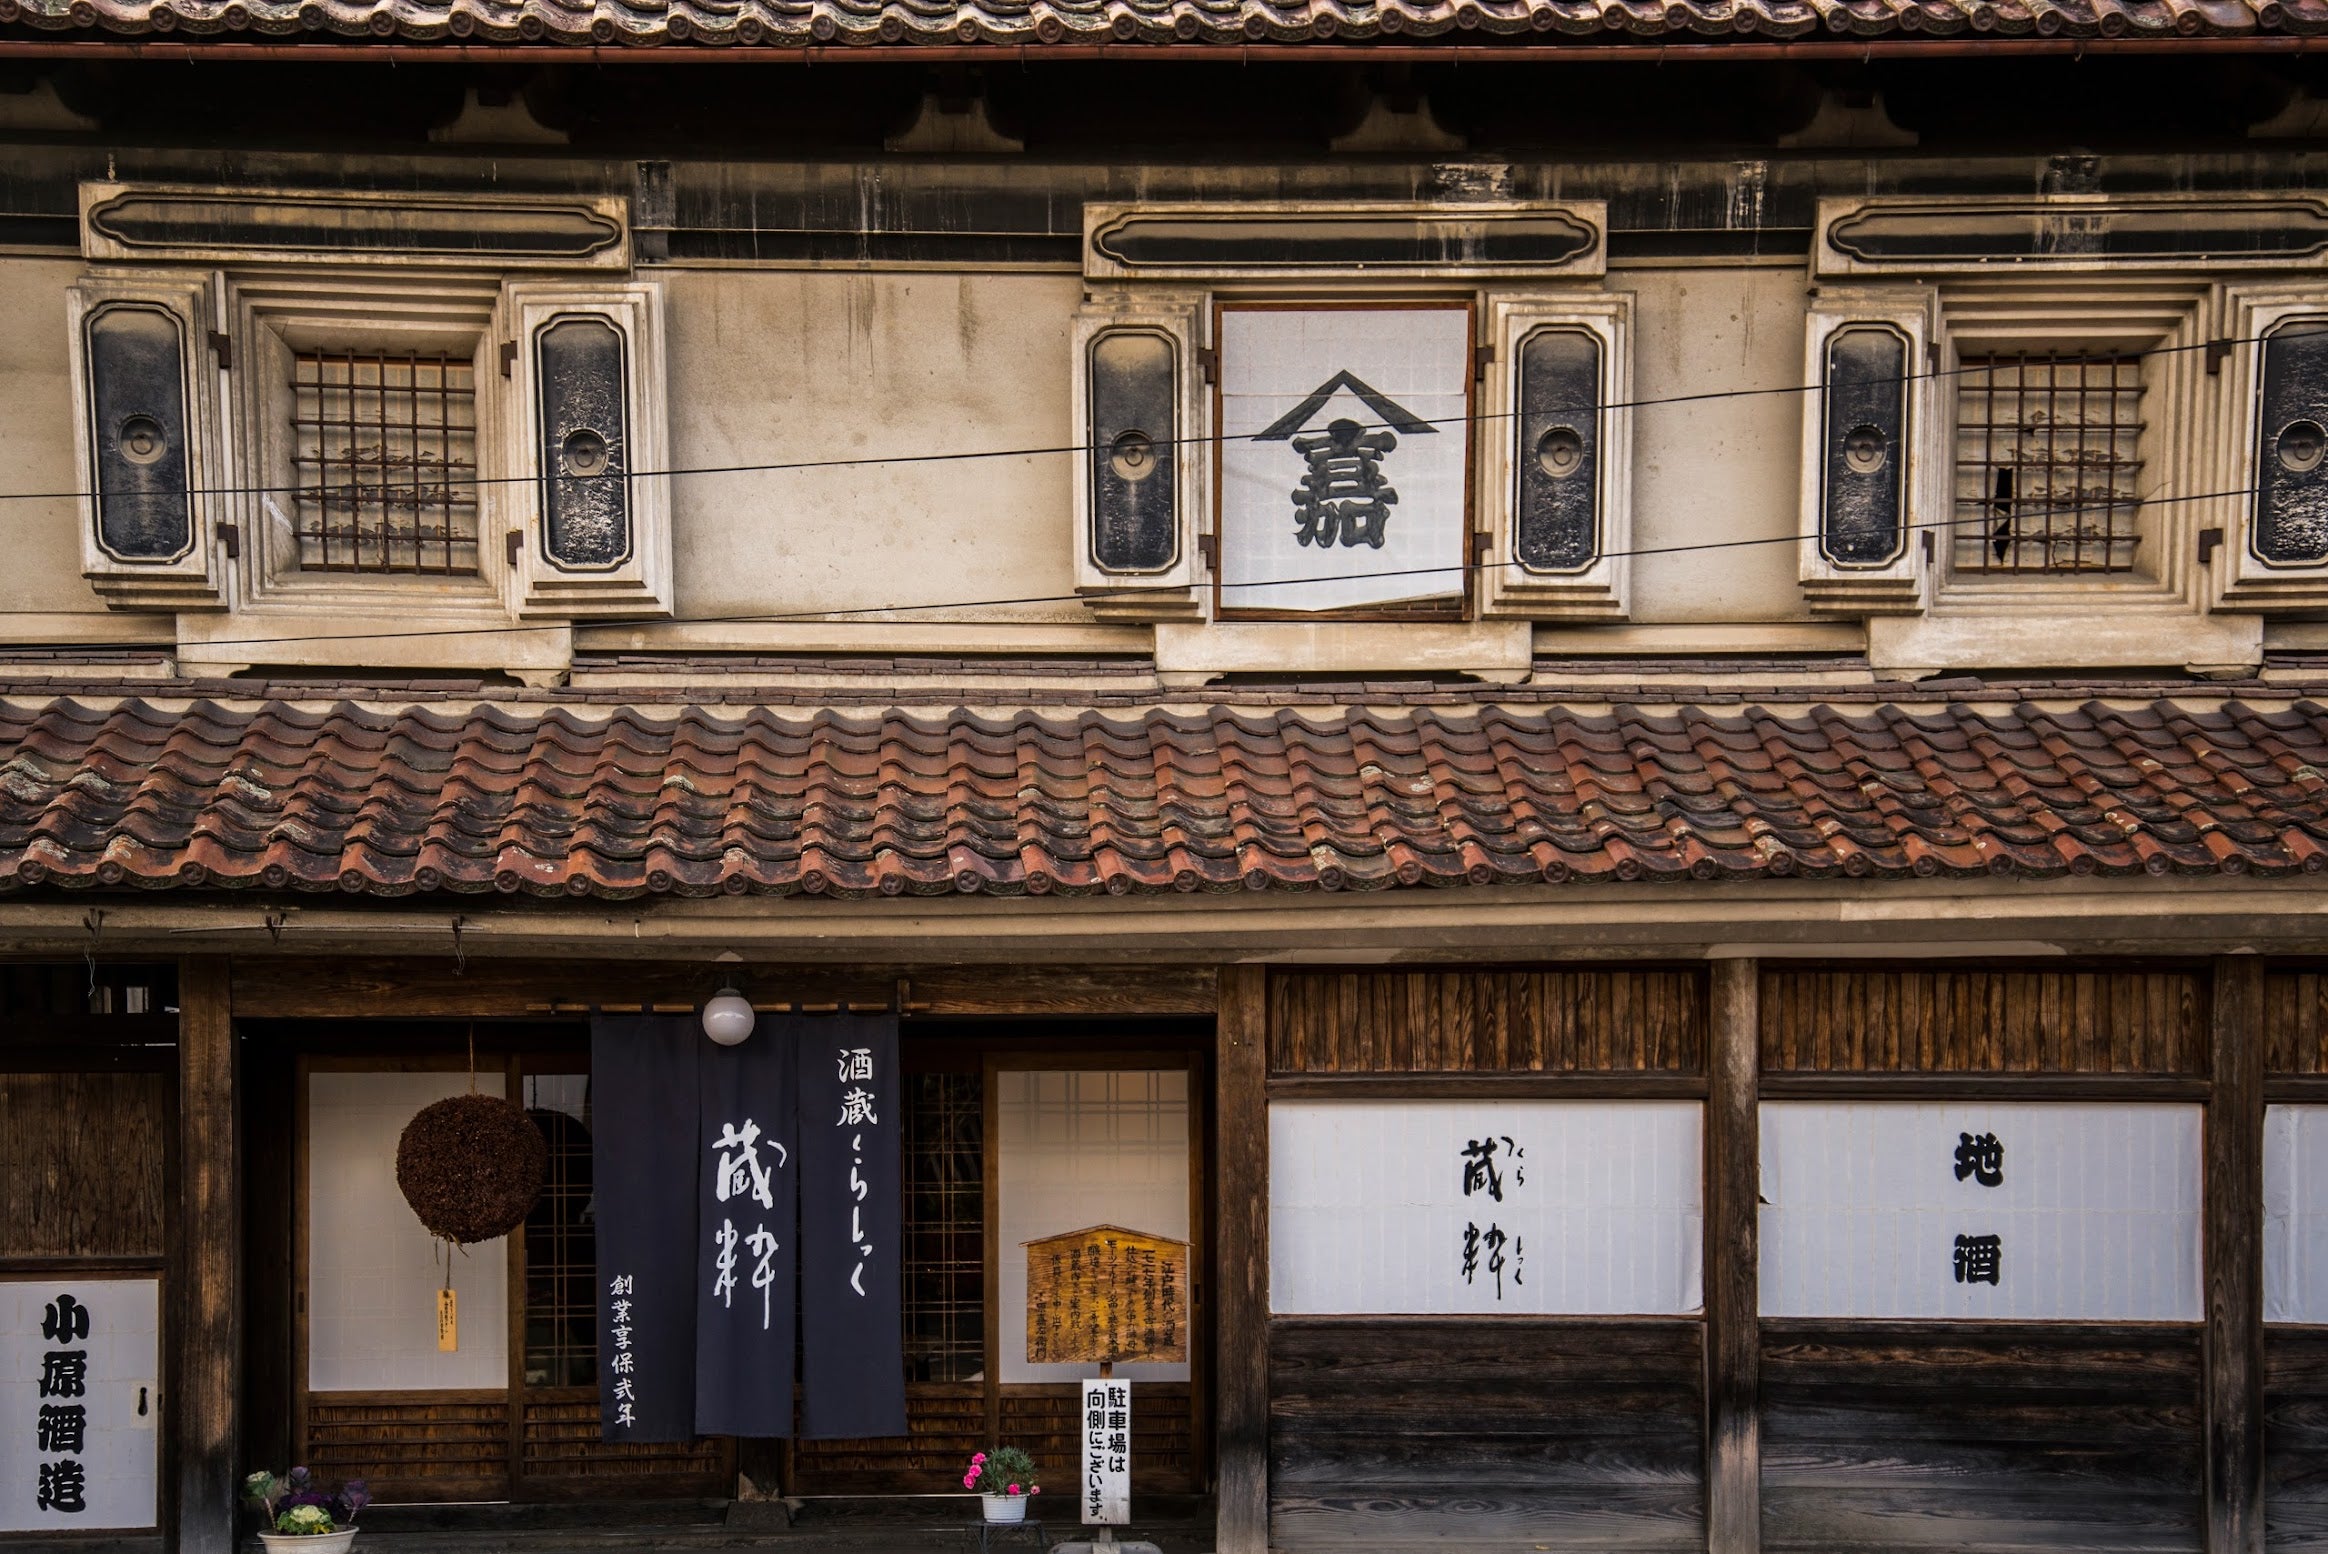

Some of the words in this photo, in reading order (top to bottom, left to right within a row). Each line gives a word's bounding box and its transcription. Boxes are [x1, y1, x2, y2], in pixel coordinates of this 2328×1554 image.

[1953, 1132, 2004, 1286] 地酒
[37, 1294, 89, 1513] 小原酒造
[1107, 1387, 1127, 1473] 駐車場は
